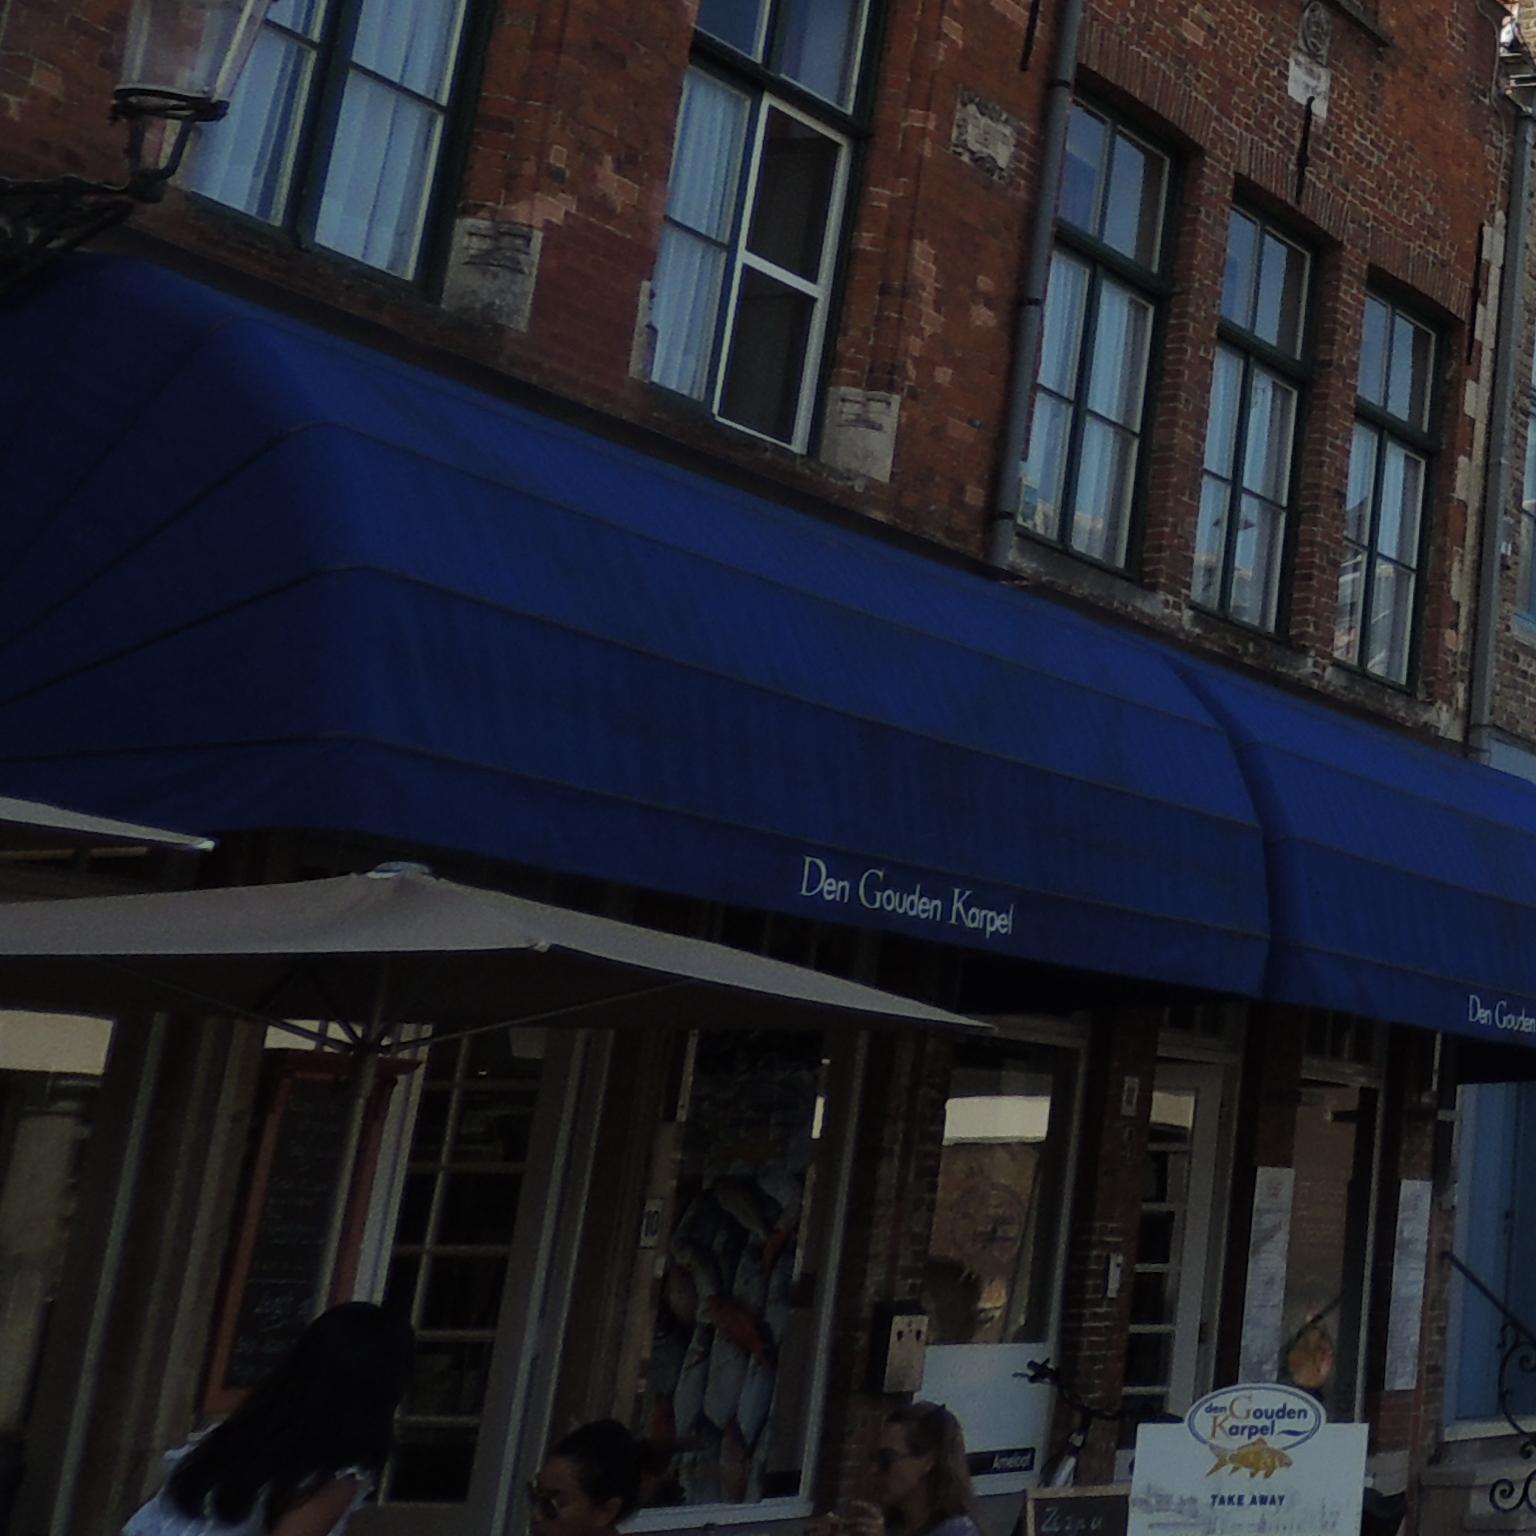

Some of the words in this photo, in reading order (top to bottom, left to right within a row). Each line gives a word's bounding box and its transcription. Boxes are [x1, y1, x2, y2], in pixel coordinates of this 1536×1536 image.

[800, 855, 849, 904] Den
[859, 867, 943, 922] Gouden
[948, 886, 1014, 940] Karpel
[1469, 994, 1492, 1025] Den
[1495, 1000, 1536, 1033] Gouden
[1204, 1402, 1227, 1415] den
[1229, 1395, 1308, 1420] Gouden
[1211, 1413, 1275, 1440] Karpel
[1210, 1494, 1245, 1507] TAKE
[1249, 1494, 1286, 1507] AWAY
